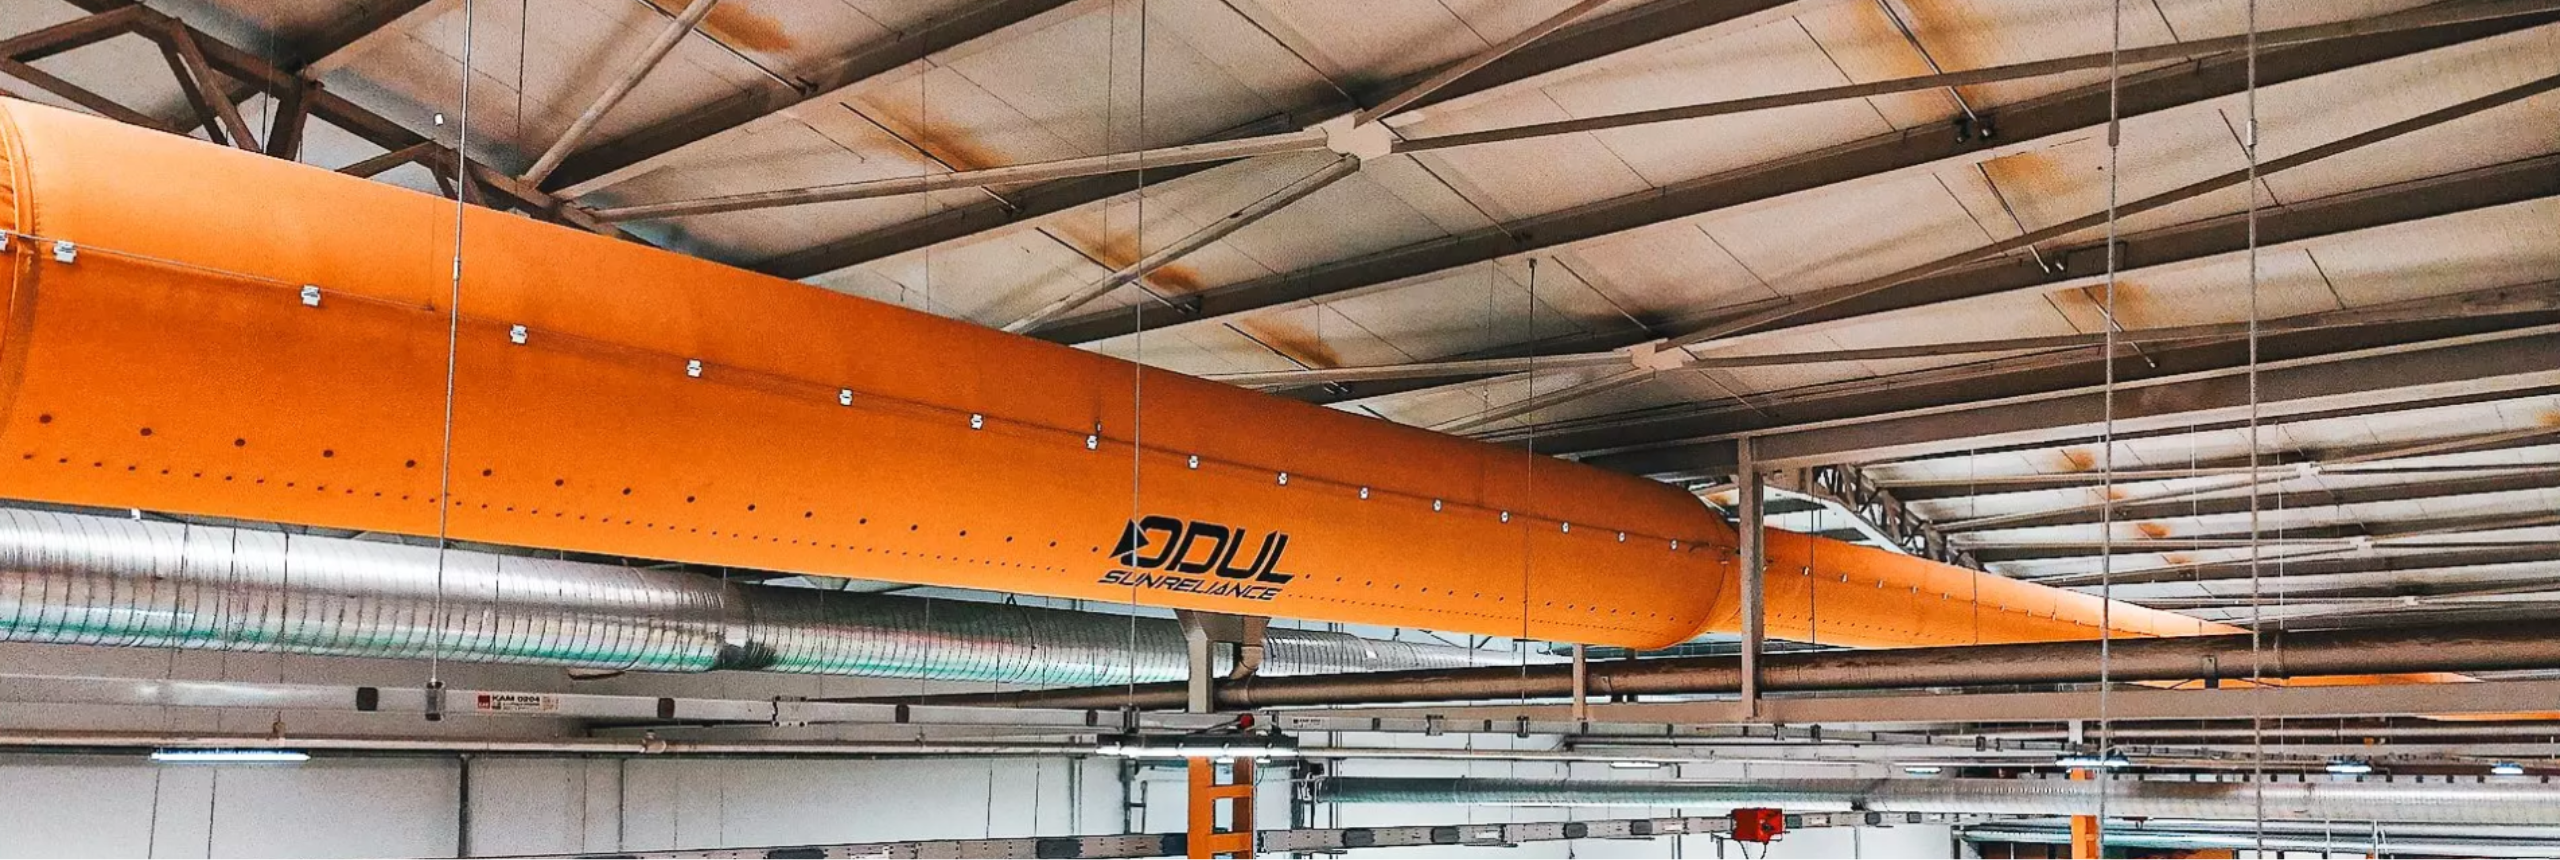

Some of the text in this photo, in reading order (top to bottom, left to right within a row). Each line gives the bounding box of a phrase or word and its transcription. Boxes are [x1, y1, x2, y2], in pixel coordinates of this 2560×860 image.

[1113, 515, 1294, 584] ODUL
[1097, 569, 1283, 600] SUNRELIANCE
[492, 694, 515, 702] KAM
